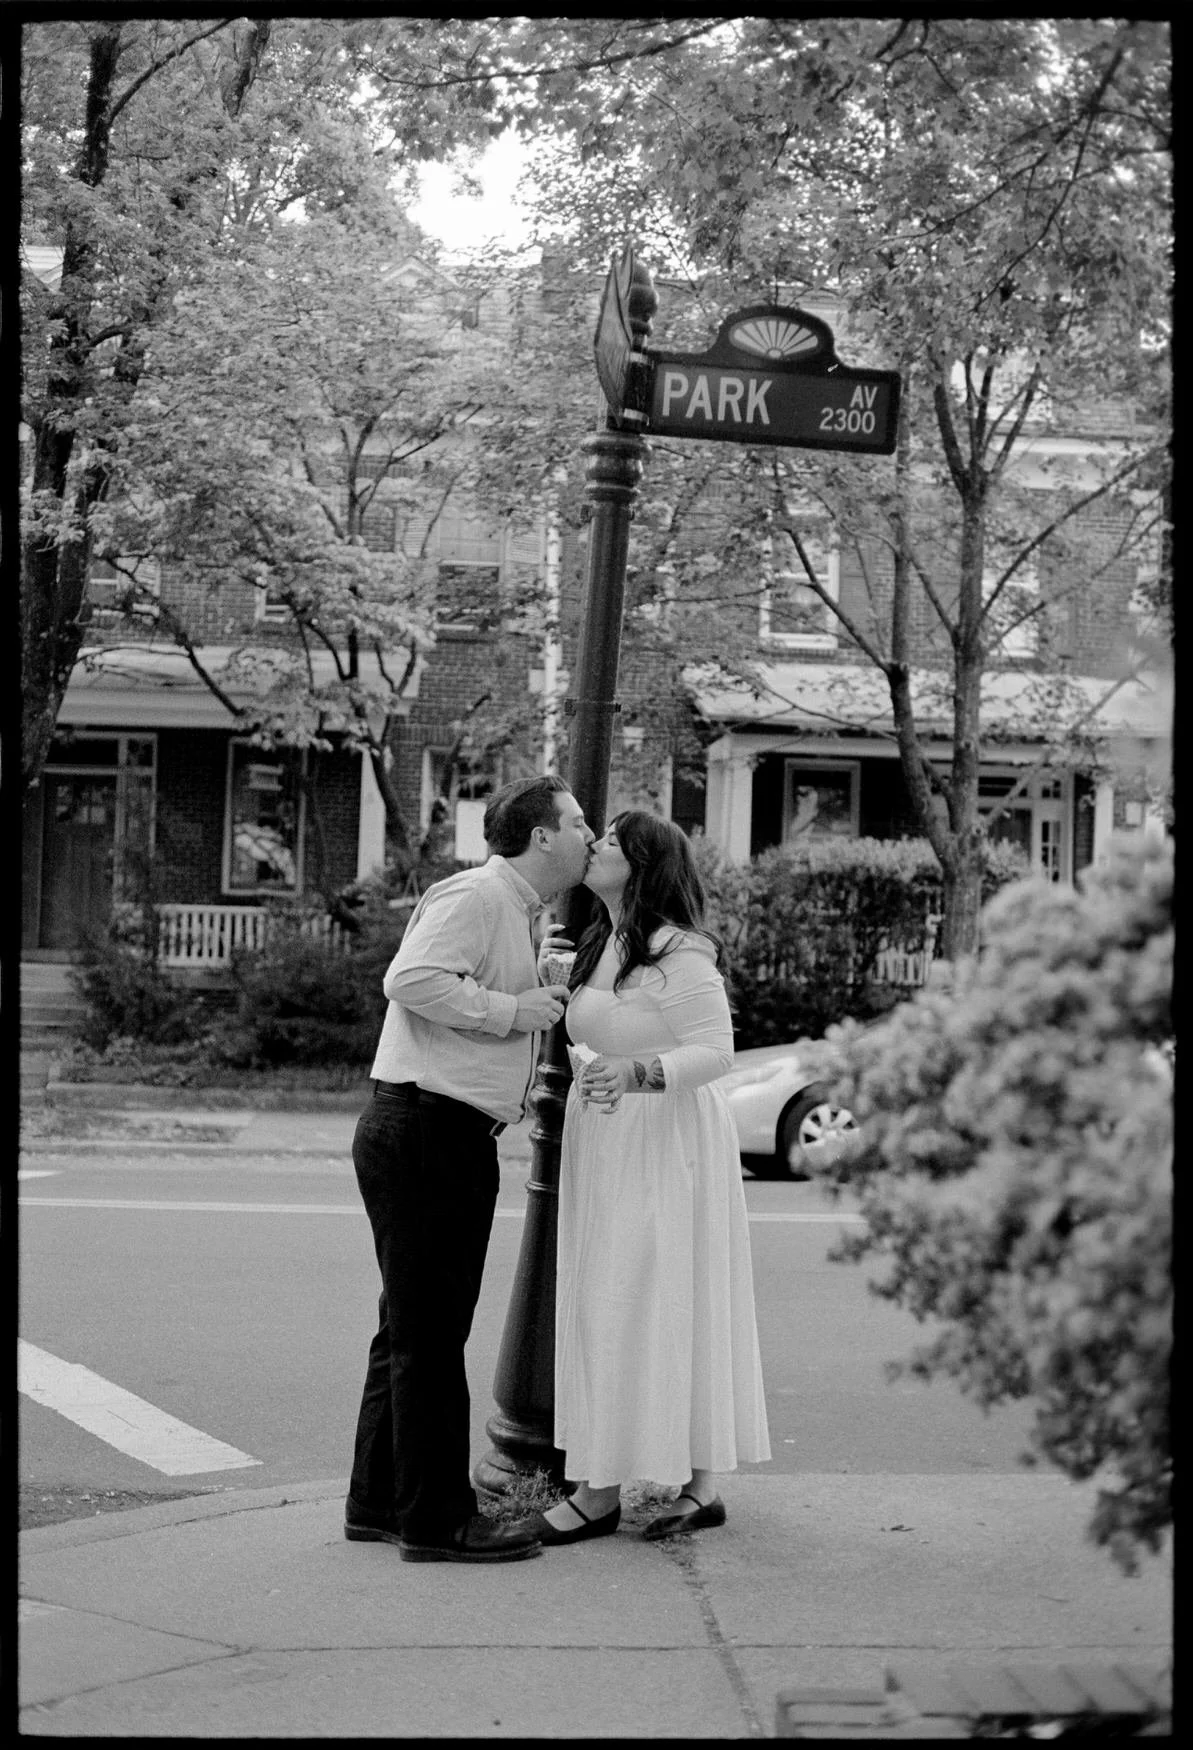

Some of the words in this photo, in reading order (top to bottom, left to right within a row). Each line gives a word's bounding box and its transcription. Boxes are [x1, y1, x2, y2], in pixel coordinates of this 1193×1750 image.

[662, 372, 772, 424] PARK
[850, 385, 878, 409] AV
[820, 408, 876, 434] 2300
